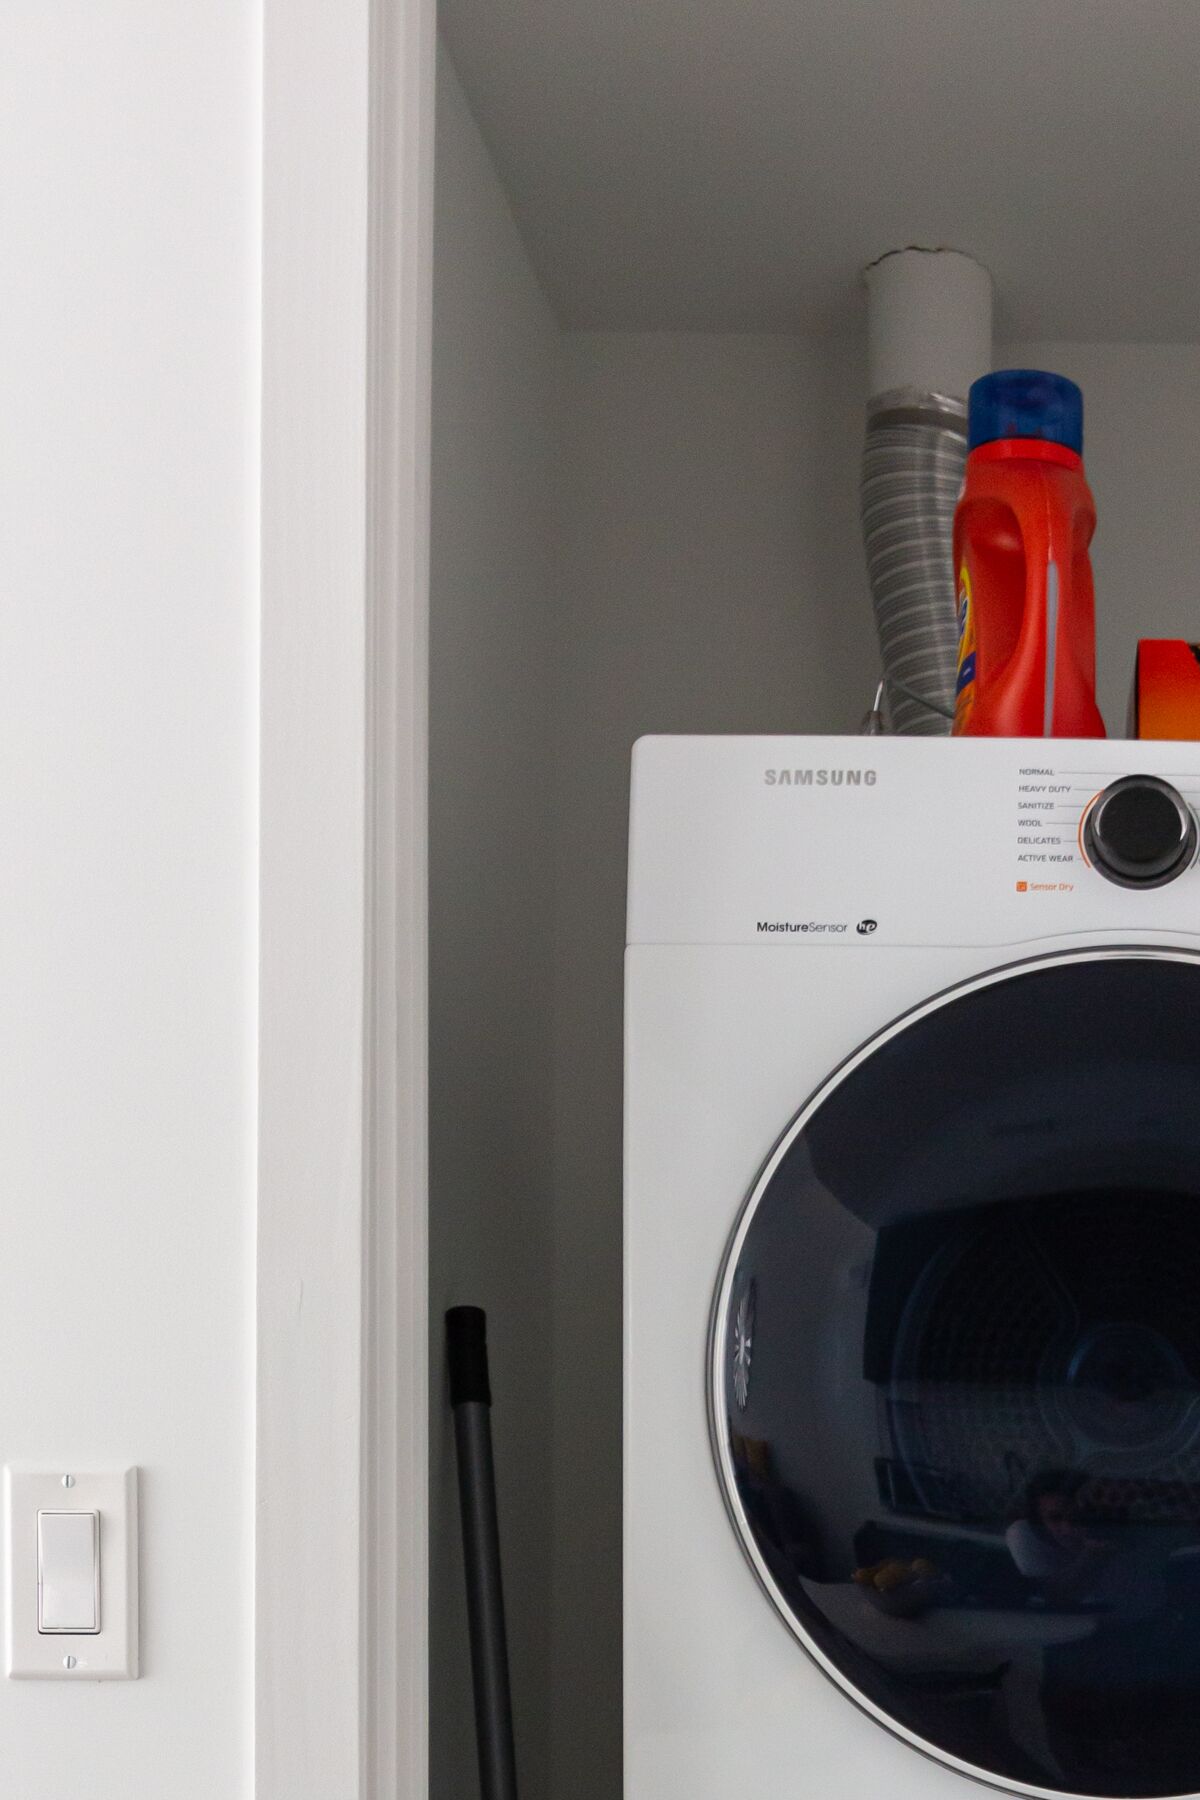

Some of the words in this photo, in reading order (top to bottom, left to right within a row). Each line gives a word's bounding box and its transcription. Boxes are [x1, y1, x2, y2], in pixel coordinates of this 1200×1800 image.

[1018, 768, 1055, 776] NORMAL
[764, 769, 877, 786] SAMSUNG
[1018, 785, 1046, 793] HEAVY
[1048, 785, 1071, 793] DUTY
[1018, 802, 1054, 810] SANITIZE
[1018, 819, 1042, 827] WOOL
[1017, 837, 1061, 845] DELICATES
[1017, 854, 1047, 862] ACTIVE
[1048, 854, 1073, 862] WEAR
[1030, 882, 1057, 891] Sensor
[1058, 882, 1074, 892] Dry
[756, 921, 848, 933] MoistureSensor
